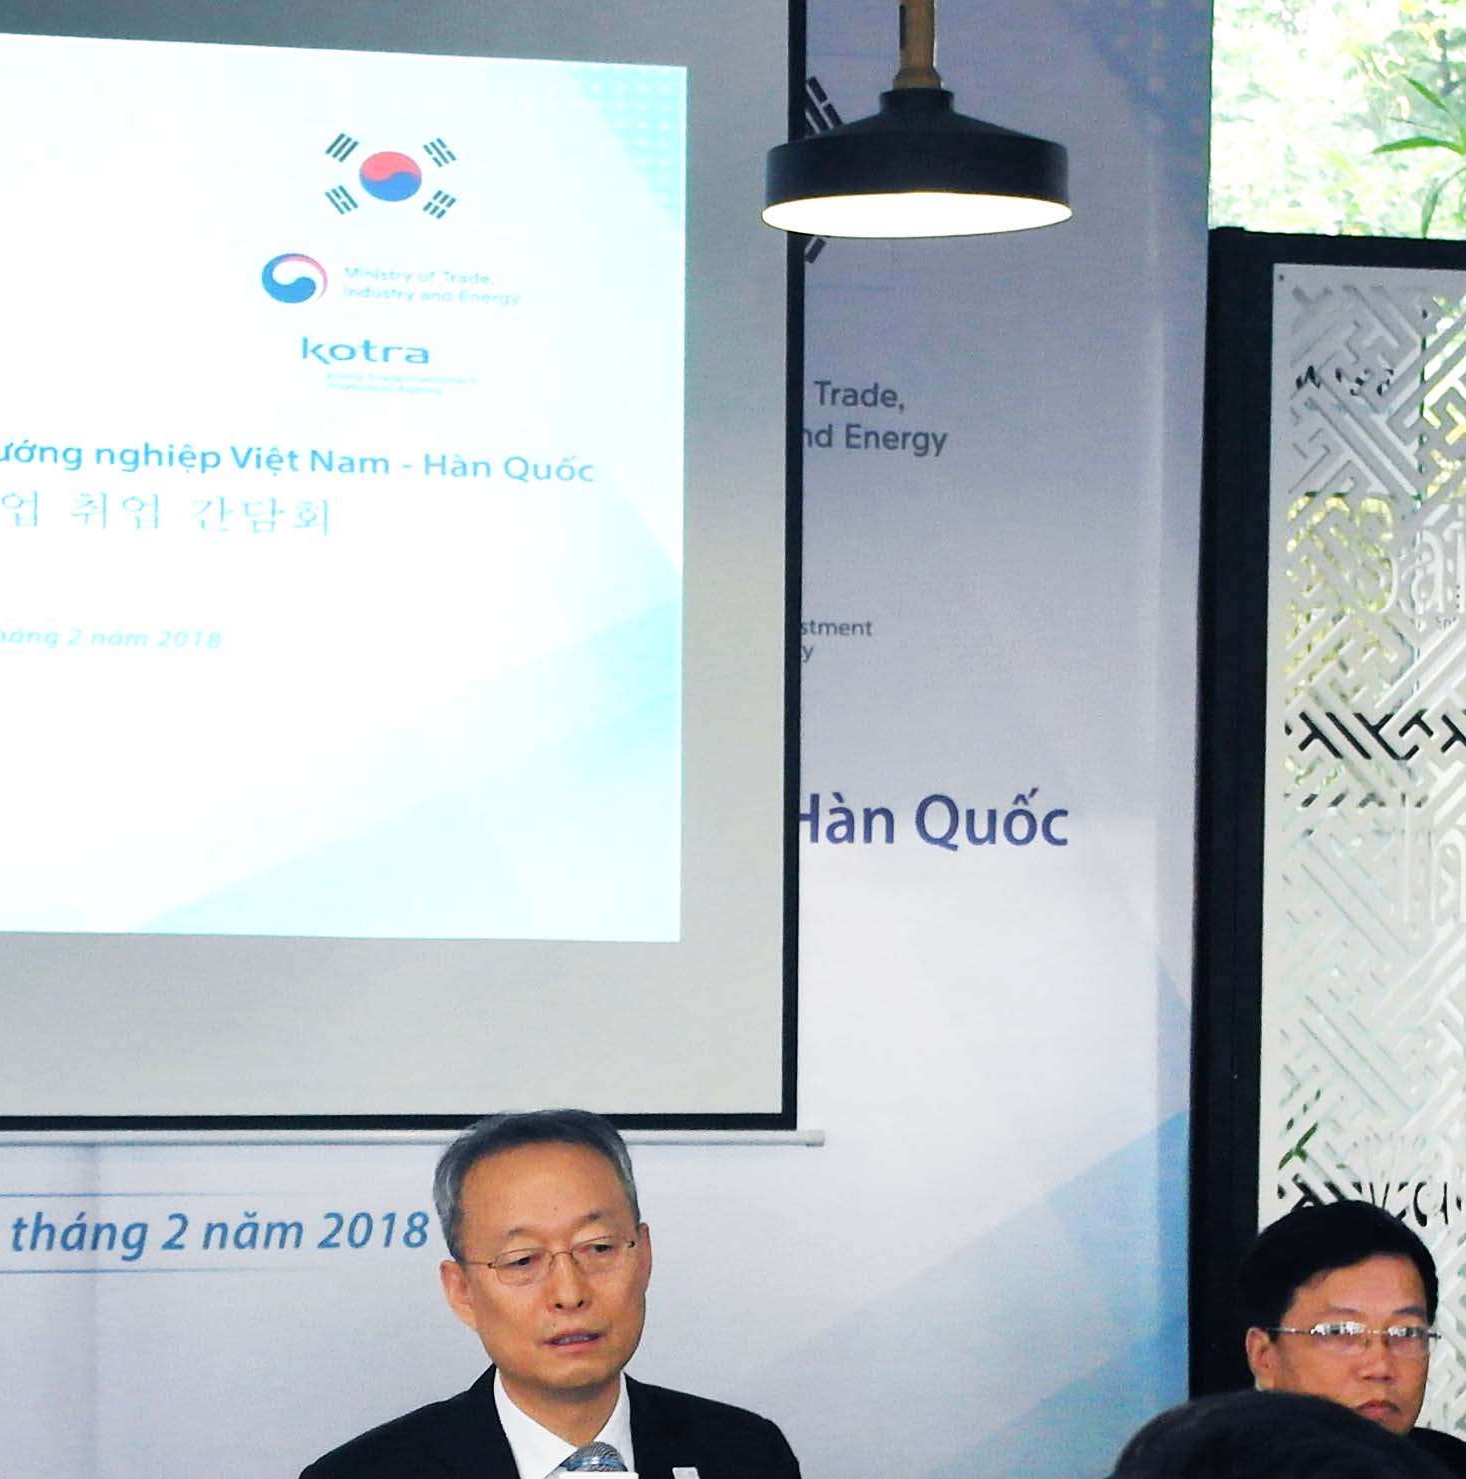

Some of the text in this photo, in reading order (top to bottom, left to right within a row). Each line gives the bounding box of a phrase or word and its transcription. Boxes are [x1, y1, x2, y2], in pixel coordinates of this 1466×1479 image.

[344, 265, 412, 283] Ministry
[343, 285, 520, 307] Industry and Energy
[302, 336, 430, 364] kotra
[814, 380, 904, 412] Trade,
[803, 424, 948, 457] nd Energy
[95, 441, 222, 474] nghiệp
[229, 445, 301, 478] Việt
[309, 449, 391, 476] Nam
[423, 453, 492, 479] Hàn
[503, 453, 596, 484] Quốc
[70, 491, 161, 531] 취업
[189, 494, 331, 538] 간담회
[66, 628, 84, 648] 2
[155, 630, 224, 651] 2018
[915, 788, 1069, 851] Quốc
[12, 1211, 149, 1262] tháng
[161, 1212, 189, 1250] 2
[202, 1210, 304, 1250] năm
[318, 1210, 430, 1249] 2018
